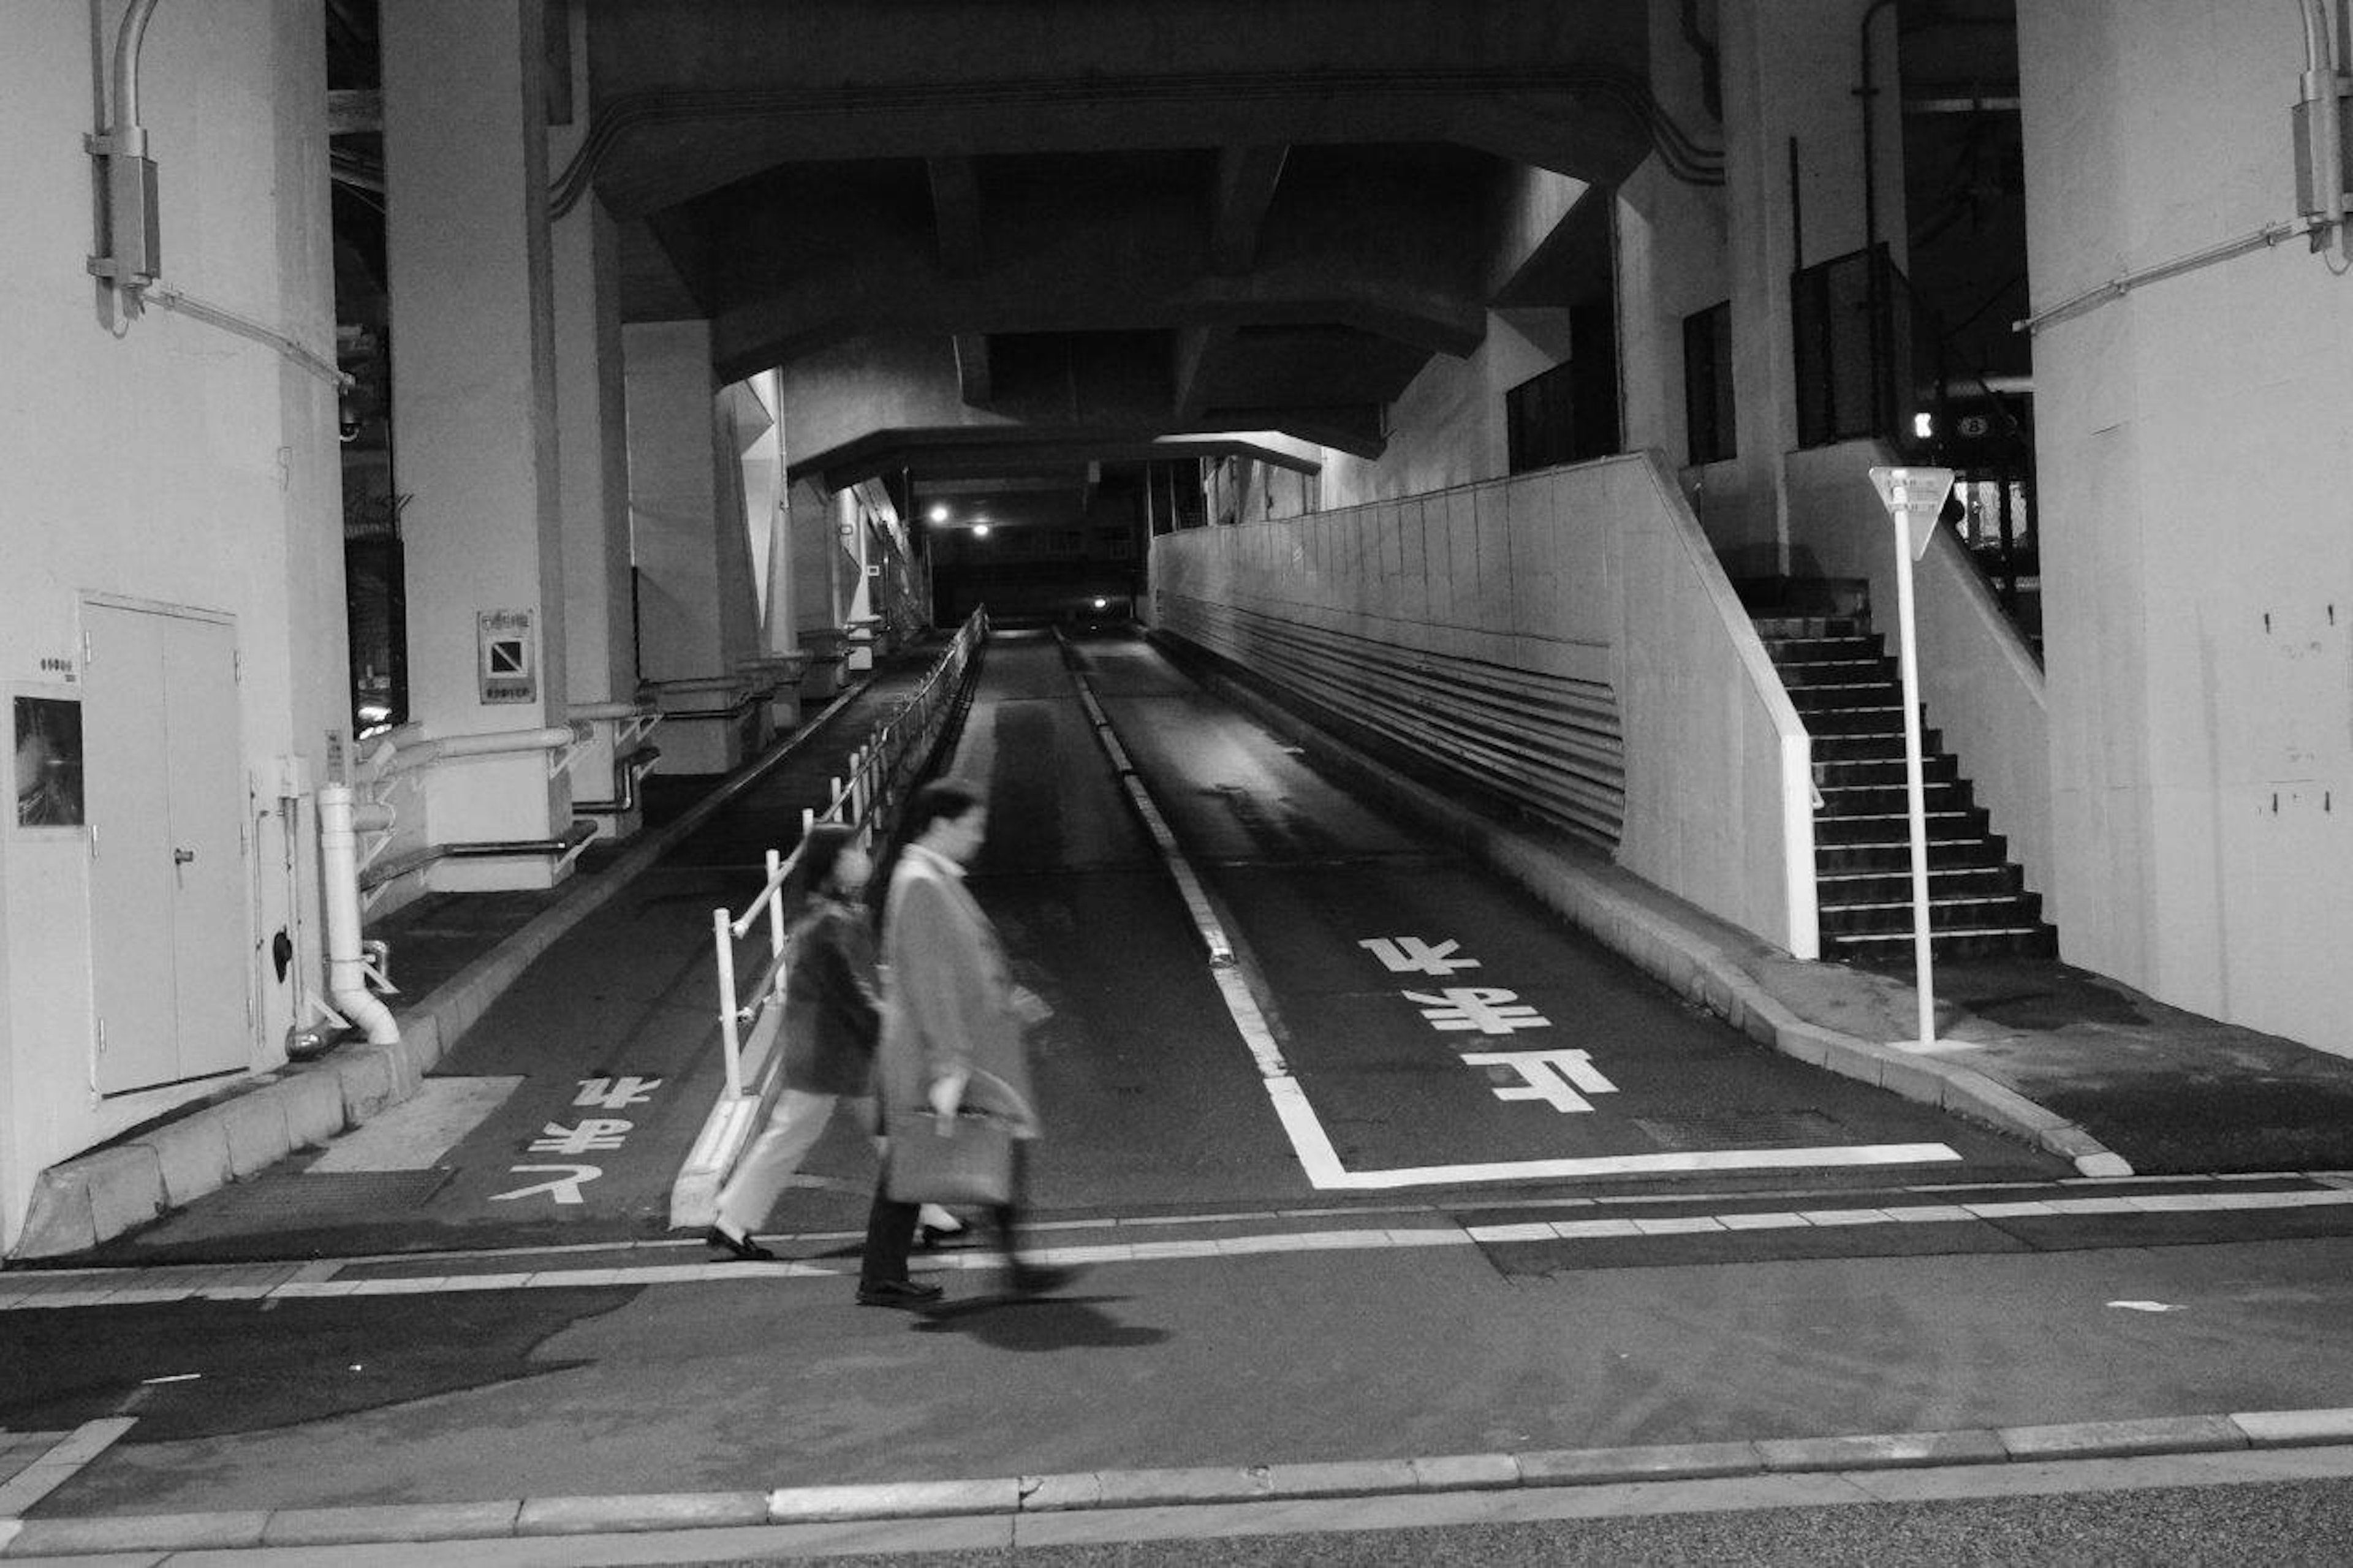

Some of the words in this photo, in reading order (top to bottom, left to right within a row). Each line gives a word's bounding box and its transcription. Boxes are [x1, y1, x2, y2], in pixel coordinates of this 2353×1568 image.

[1357, 936, 1620, 1113] 止まれ
[488, 1076, 662, 1204] とまれ
